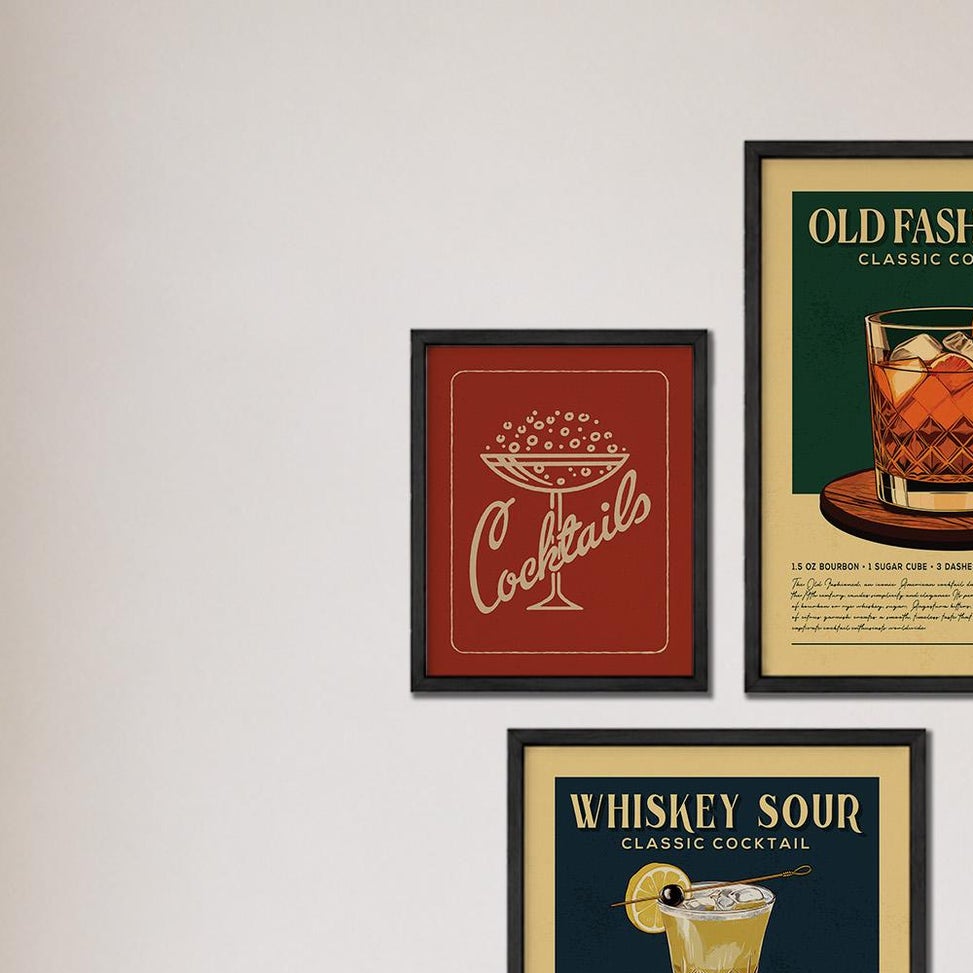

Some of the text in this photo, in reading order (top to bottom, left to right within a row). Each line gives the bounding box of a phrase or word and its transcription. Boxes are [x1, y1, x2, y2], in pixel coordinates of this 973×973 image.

[808, 207, 885, 244] OLD
[858, 253, 941, 266] CLASSIC
[469, 469, 651, 614] Cocktails
[791, 562, 803, 571] 1.5
[805, 562, 817, 571] OZ
[819, 562, 860, 571] BOURBON
[868, 562, 872, 571] 1
[874, 562, 903, 571] SUGAR
[905, 562, 928, 571] CUBE
[936, 562, 942, 571] 3
[570, 793, 862, 834] WHISKEY SOUR
[621, 837, 810, 850] CLASSIC COCKTAIL
